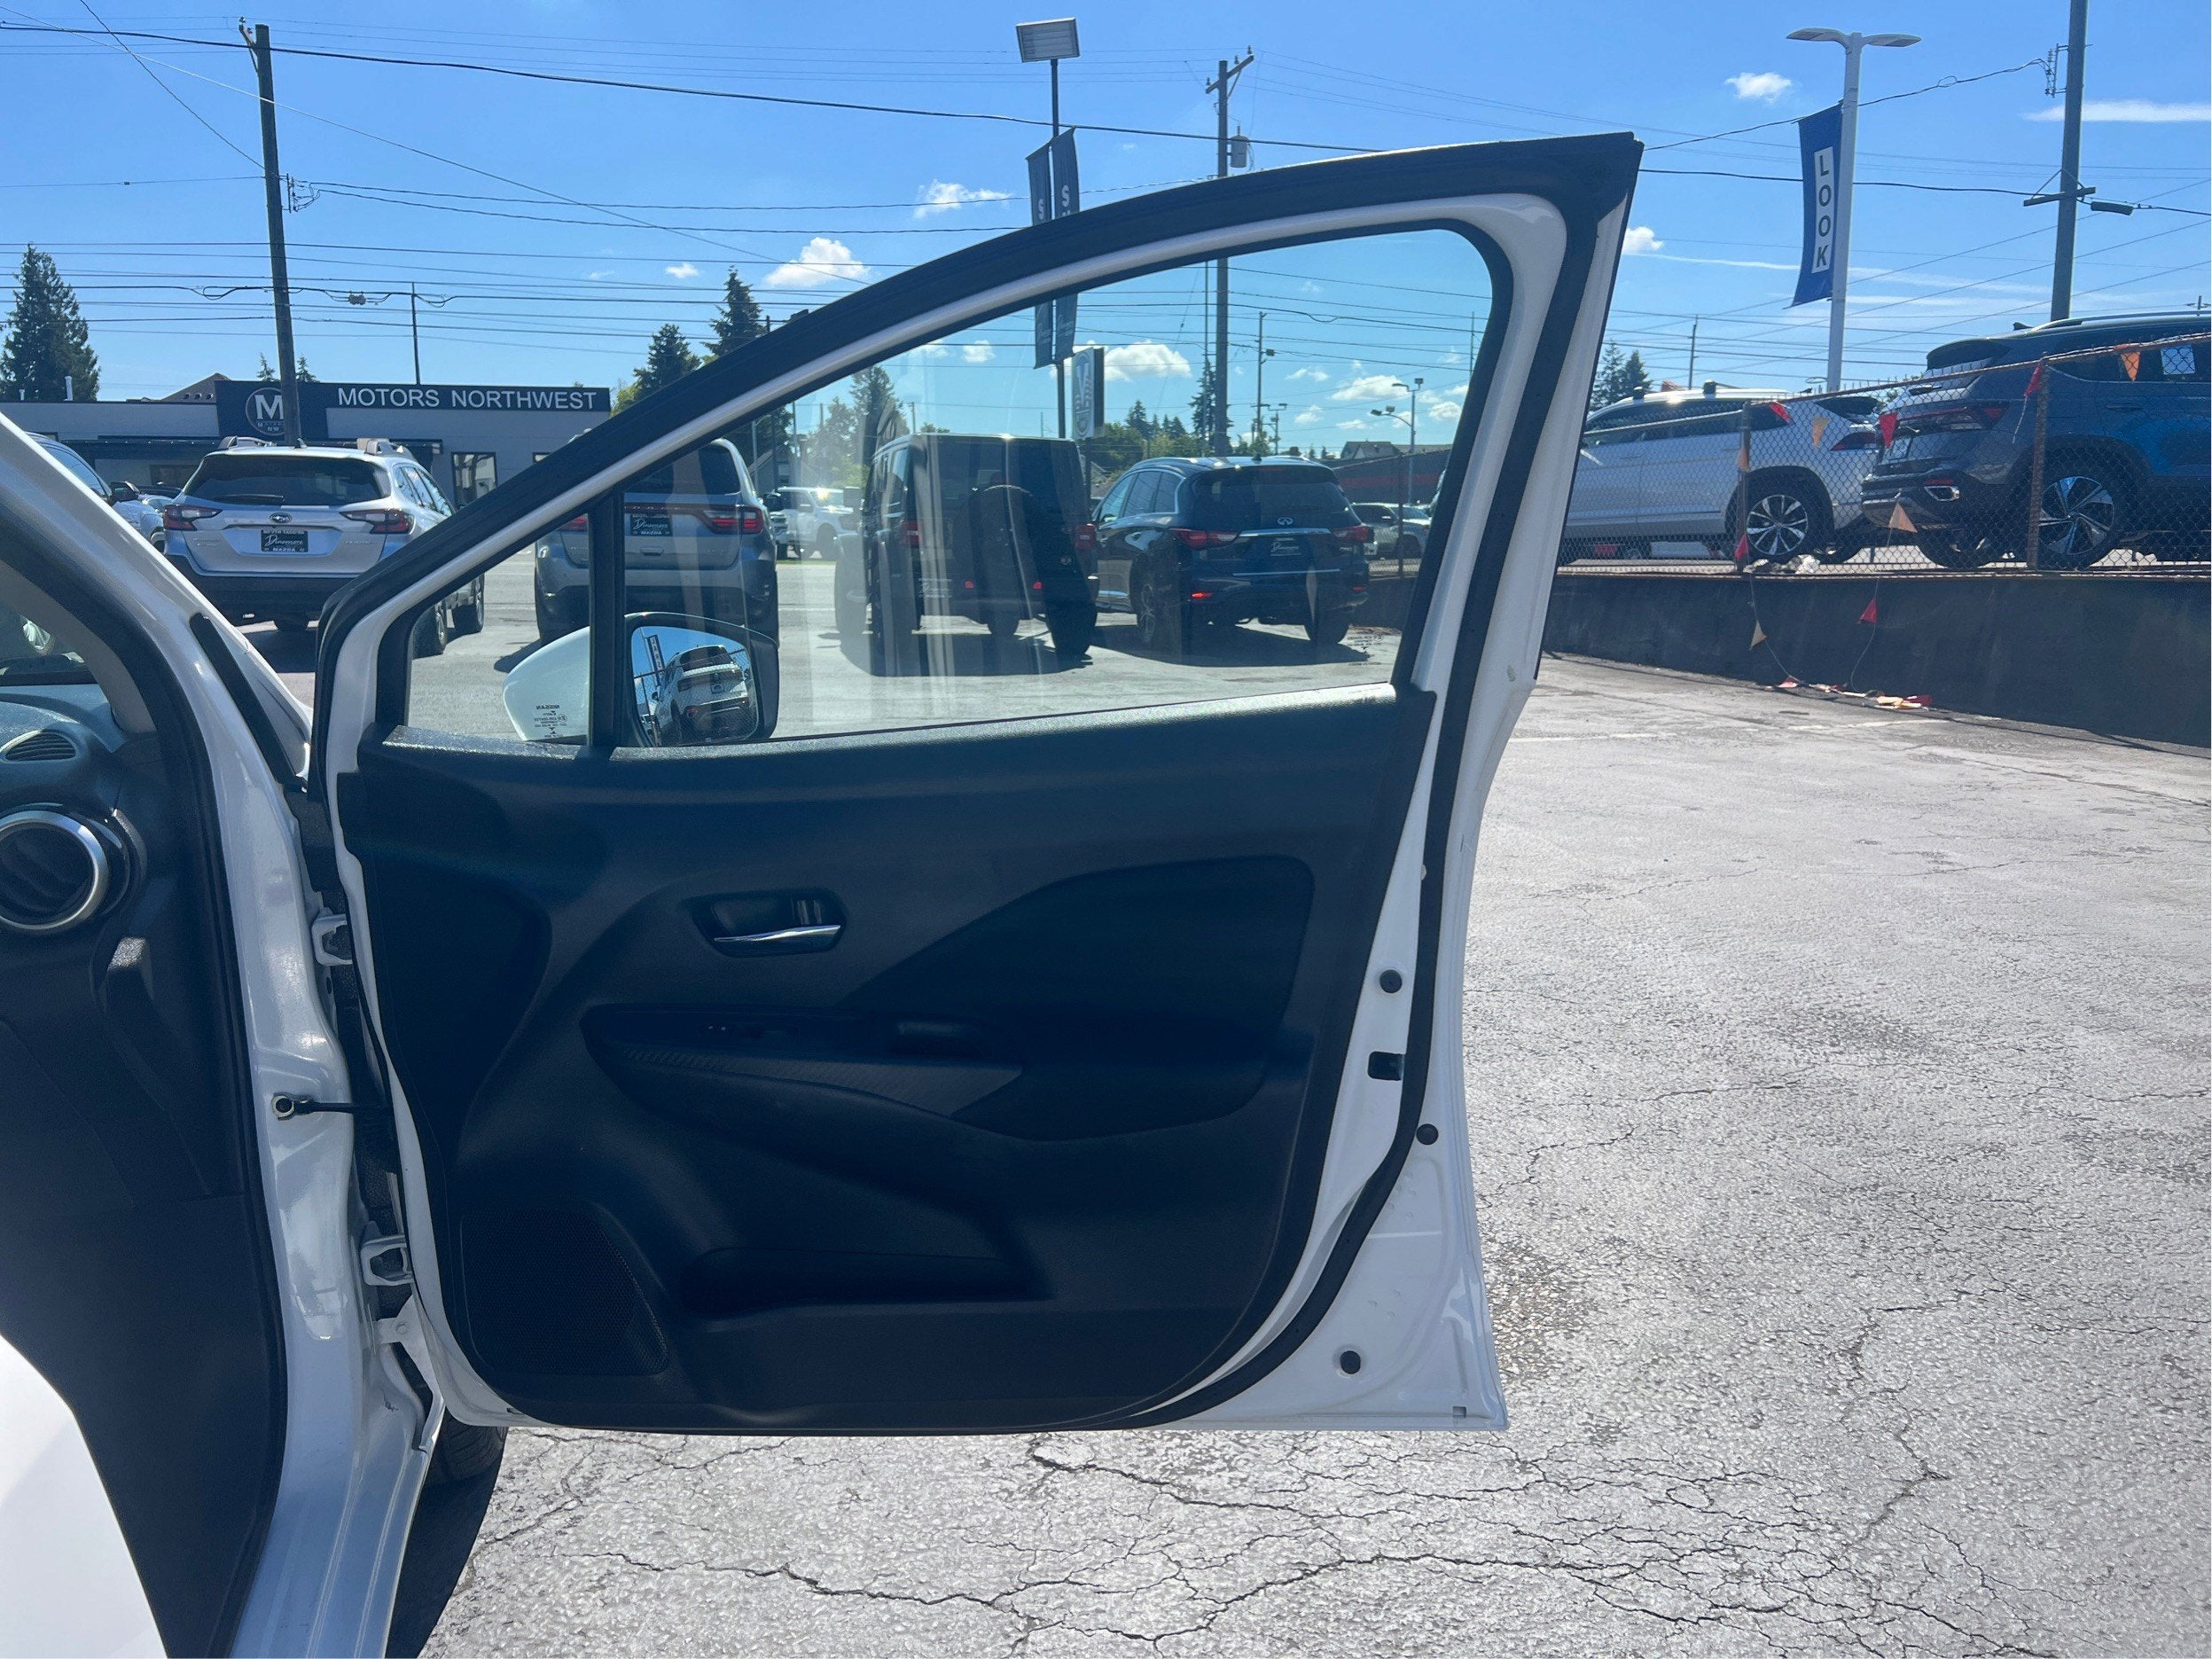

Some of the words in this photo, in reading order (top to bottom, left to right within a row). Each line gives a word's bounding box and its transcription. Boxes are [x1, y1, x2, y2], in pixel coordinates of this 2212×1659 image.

[1816, 154, 1833, 268] LOOK
[254, 395, 284, 419] M
[338, 387, 440, 407] MOTORS
[451, 389, 598, 409] NORTHWEST
